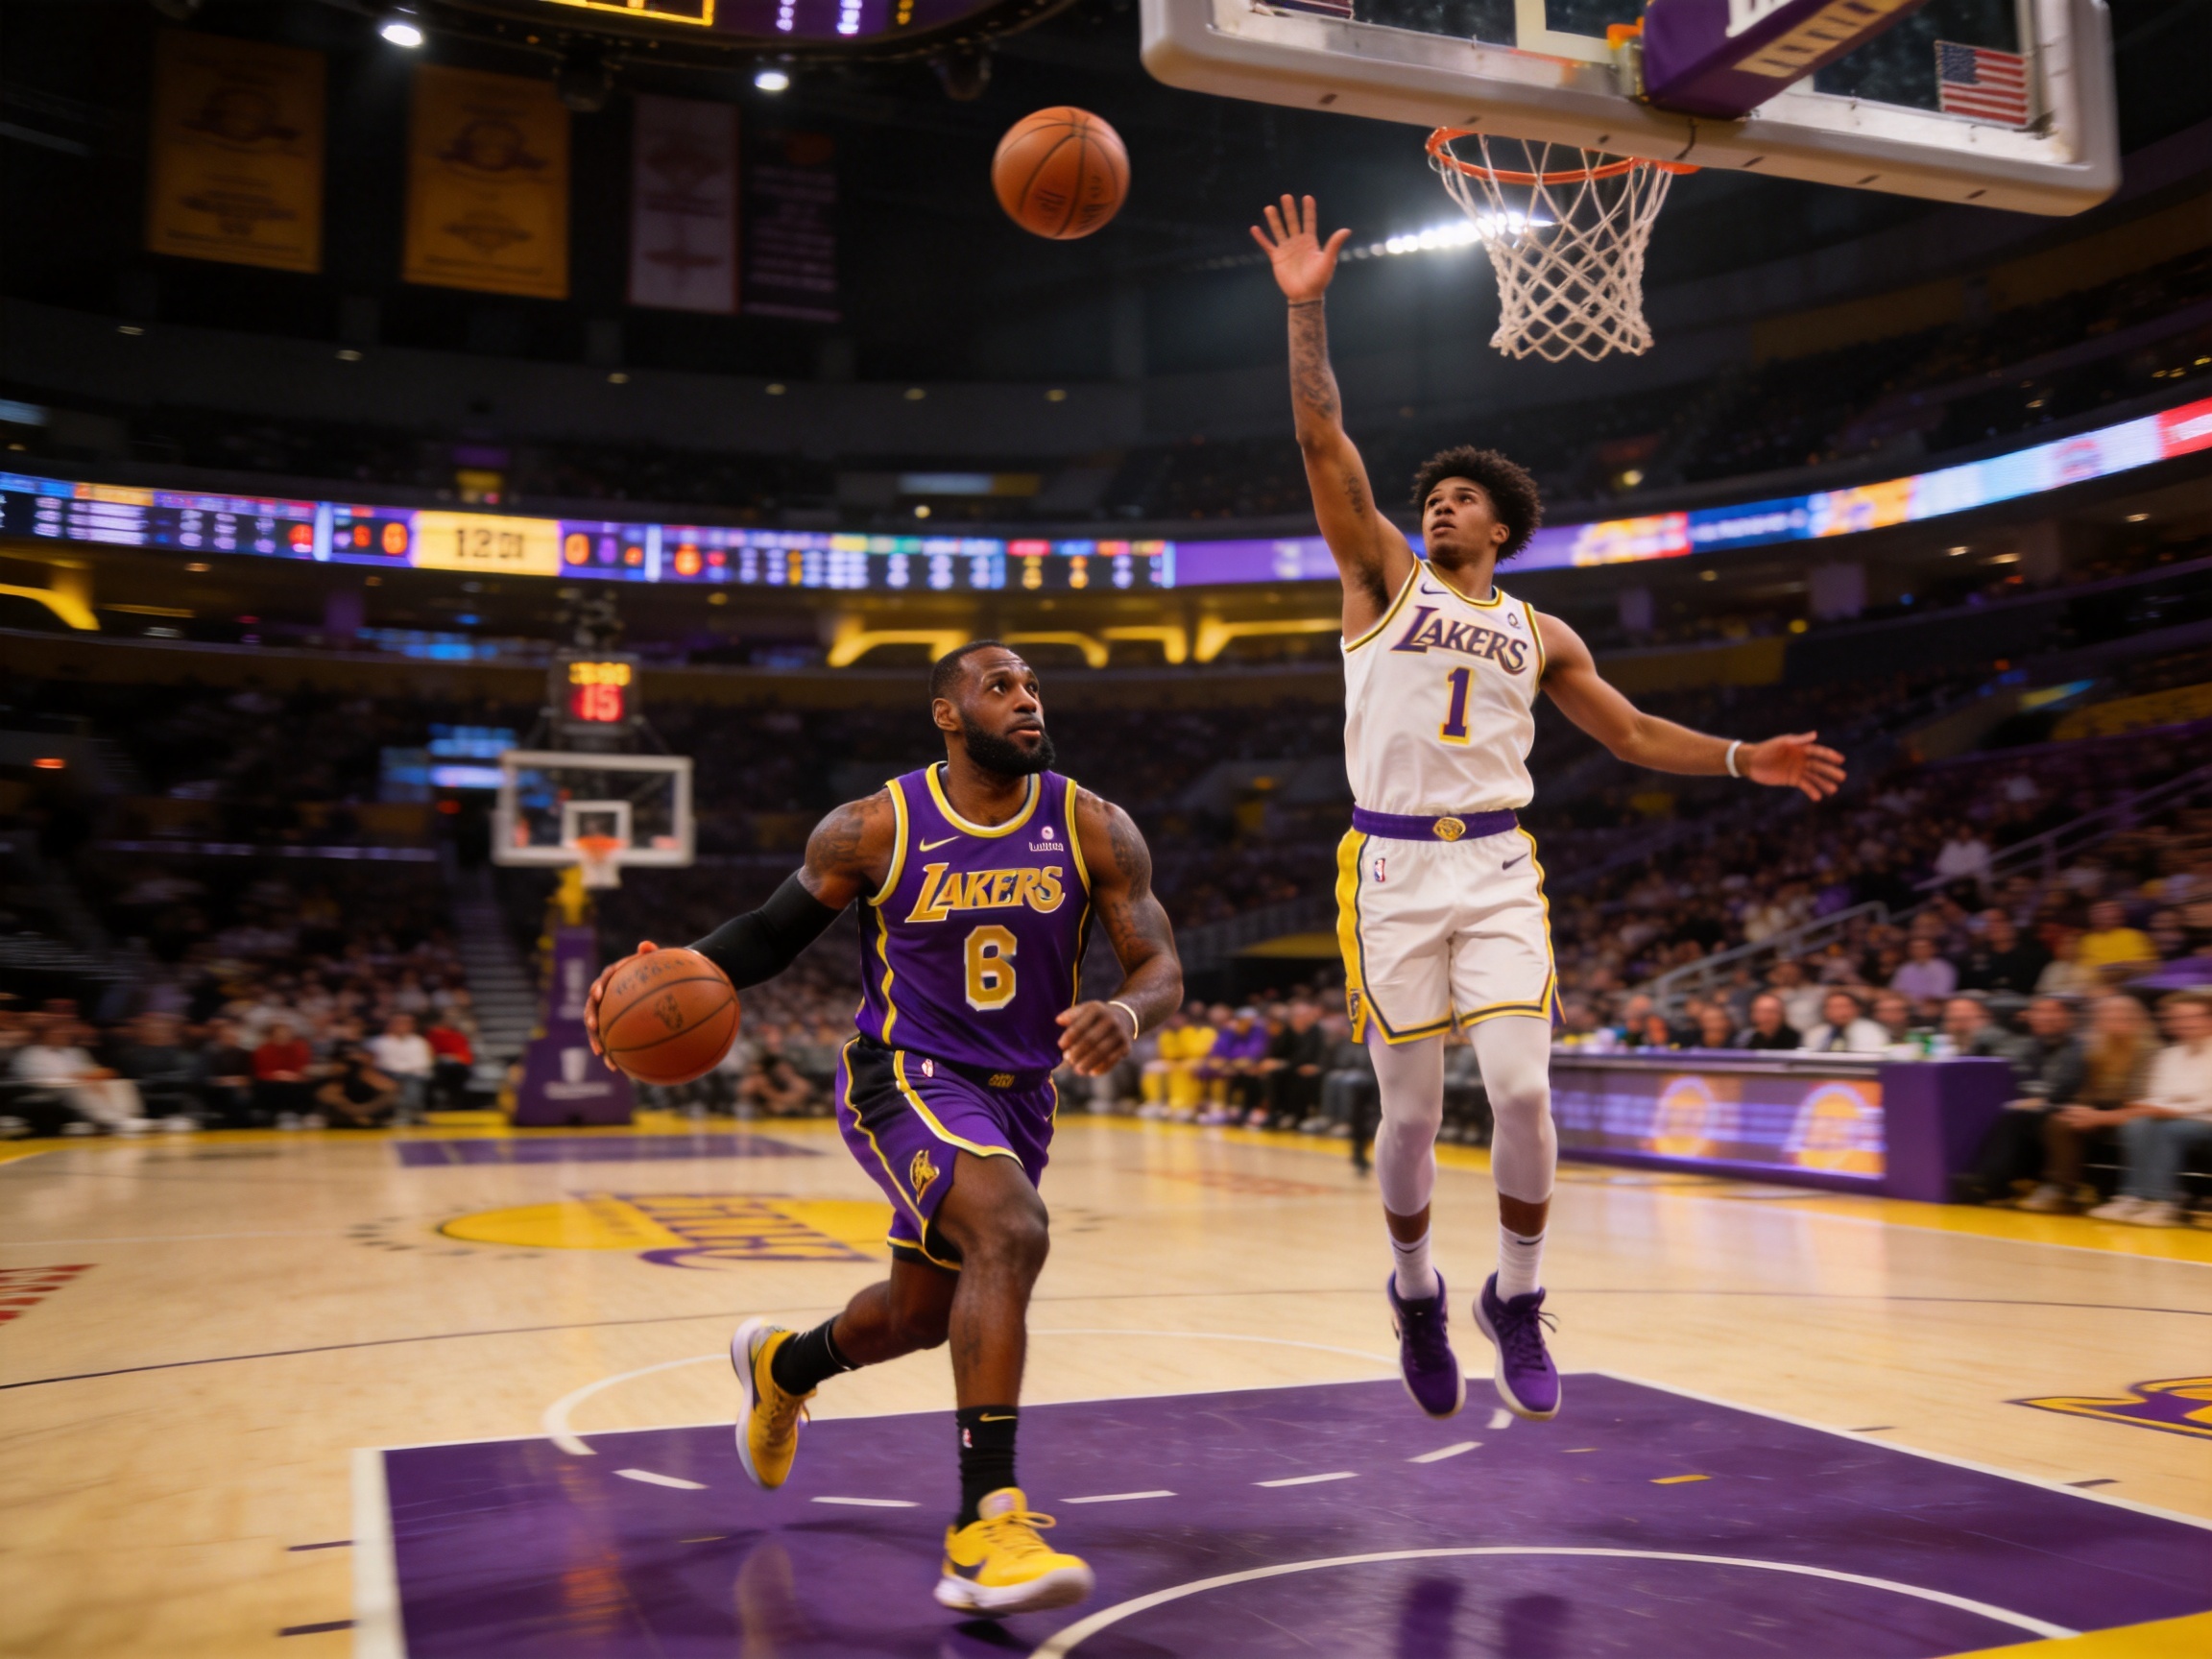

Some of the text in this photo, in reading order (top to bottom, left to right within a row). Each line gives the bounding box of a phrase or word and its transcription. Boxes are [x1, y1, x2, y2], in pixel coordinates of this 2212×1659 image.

[1389, 605, 1528, 676] LAKERS
[1439, 666, 1476, 746] 1
[903, 861, 1067, 924] LAKERS
[963, 924, 1018, 1012] 6
